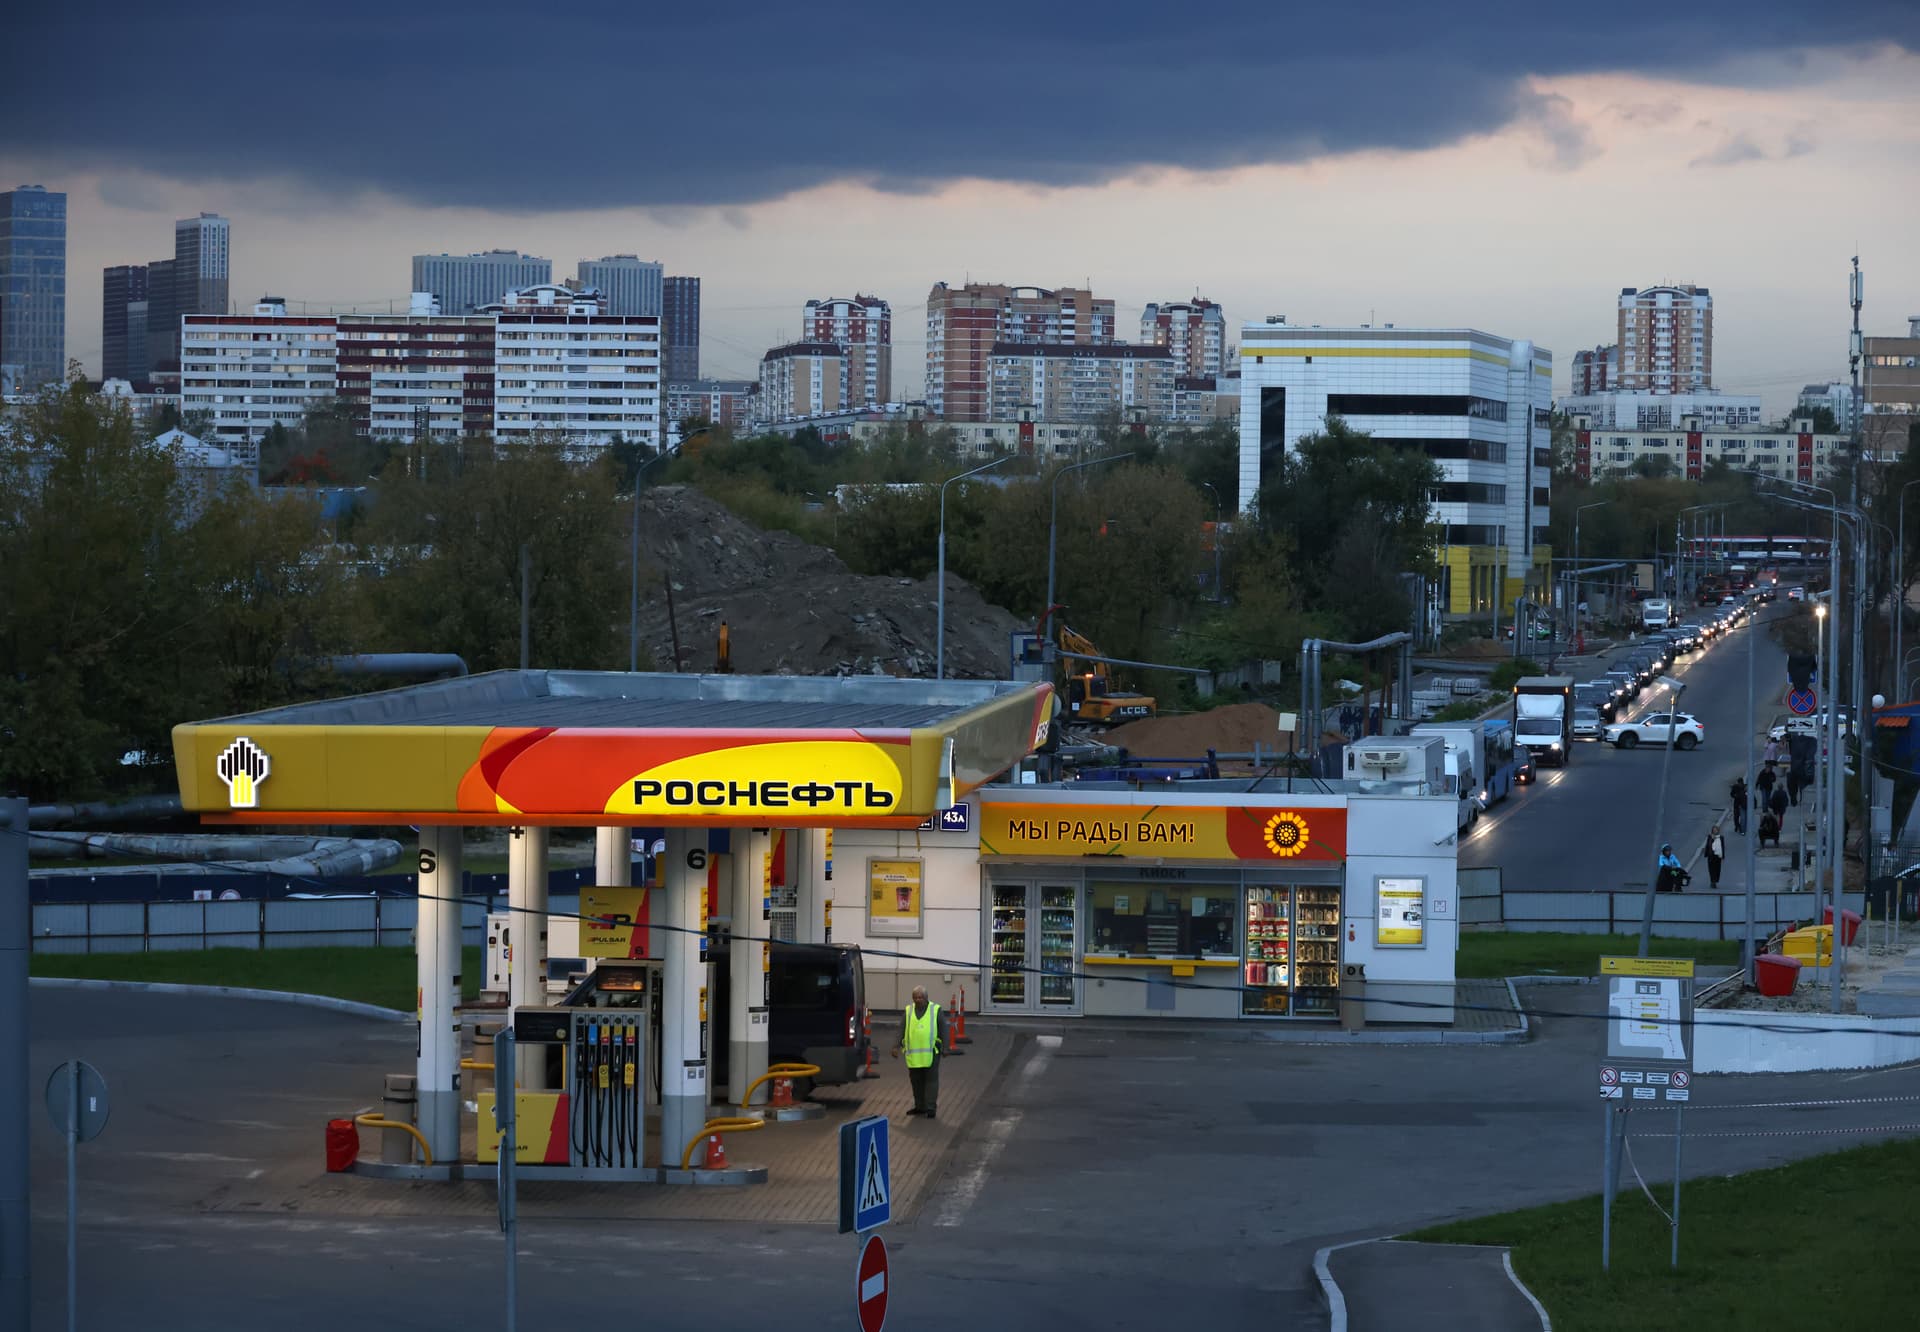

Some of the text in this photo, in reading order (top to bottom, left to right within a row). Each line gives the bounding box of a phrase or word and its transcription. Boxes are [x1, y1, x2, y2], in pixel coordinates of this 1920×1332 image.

[634, 780, 894, 807] РОСНЕФТЬ
[1009, 820, 1194, 844] МЫ РАДЫ ВАМ!
[419, 849, 436, 873] 6
[687, 849, 706, 869] 6
